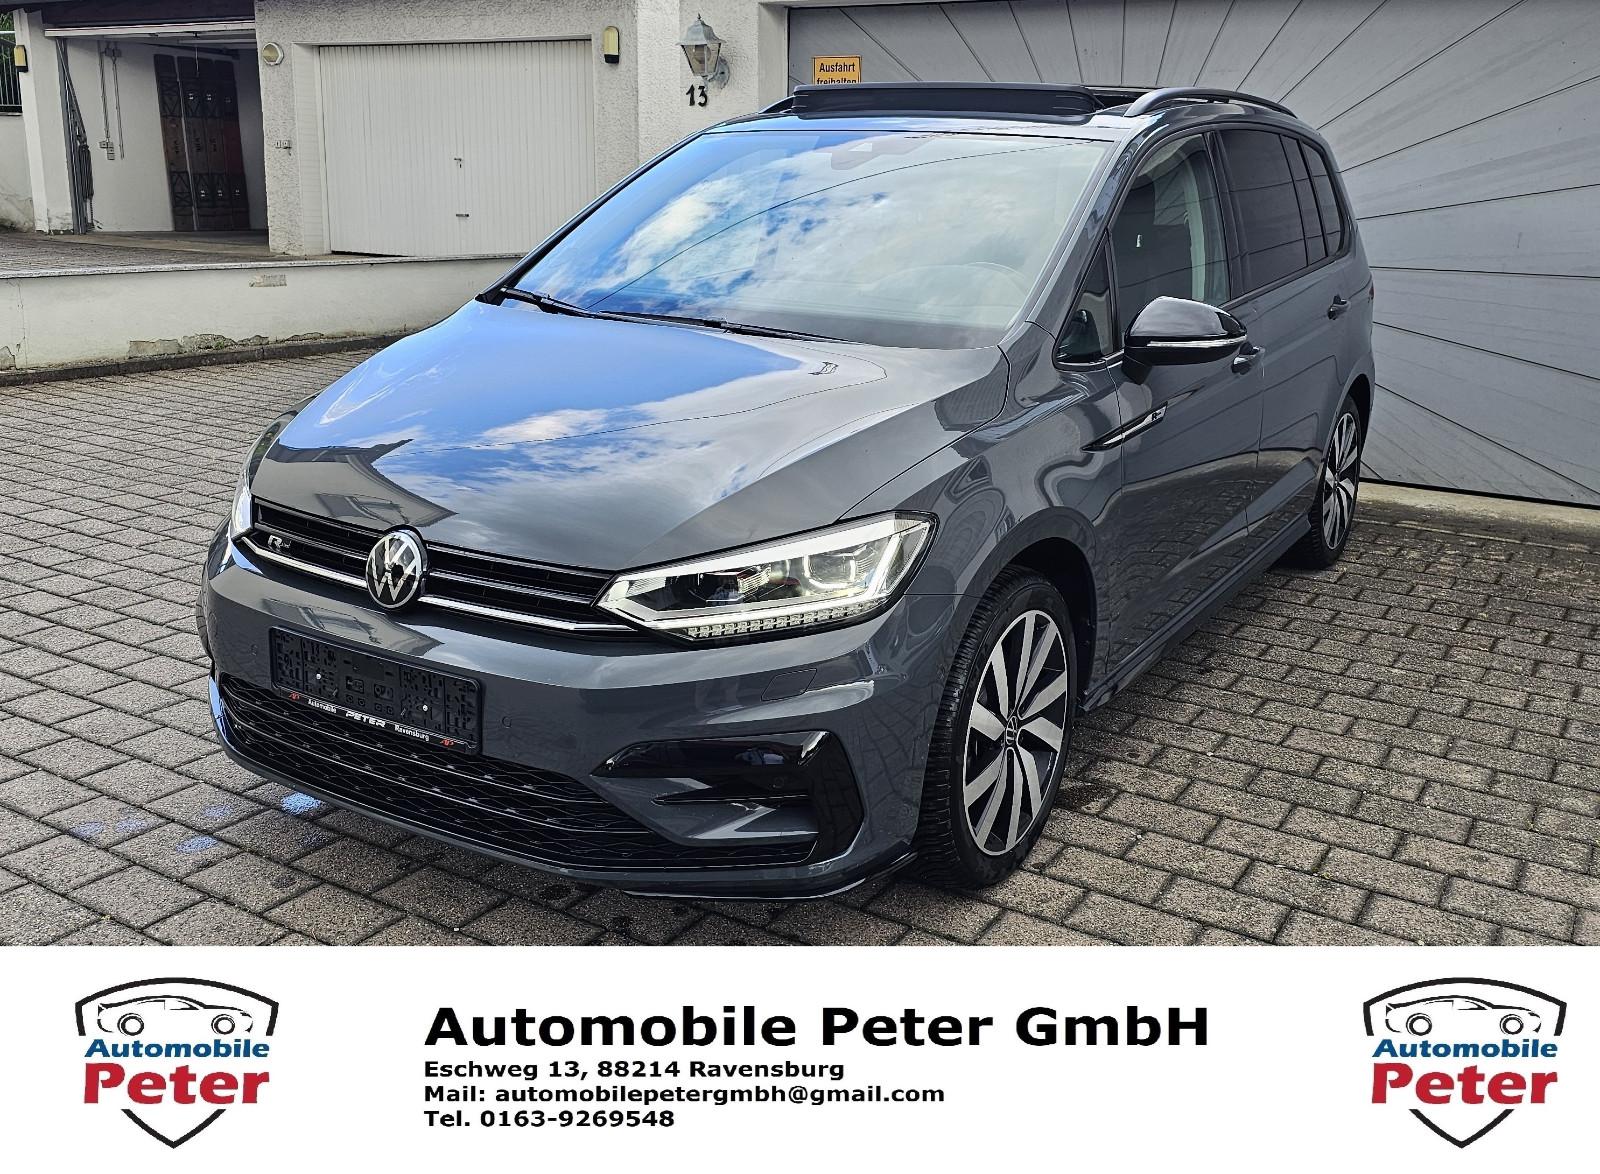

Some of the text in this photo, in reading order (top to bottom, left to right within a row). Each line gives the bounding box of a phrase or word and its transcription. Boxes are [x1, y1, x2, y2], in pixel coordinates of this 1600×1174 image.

[819, 62, 855, 73] Ausfahrt
[685, 84, 708, 107] 13
[345, 710, 386, 728] PETER
[394, 724, 430, 742] Ravensburg
